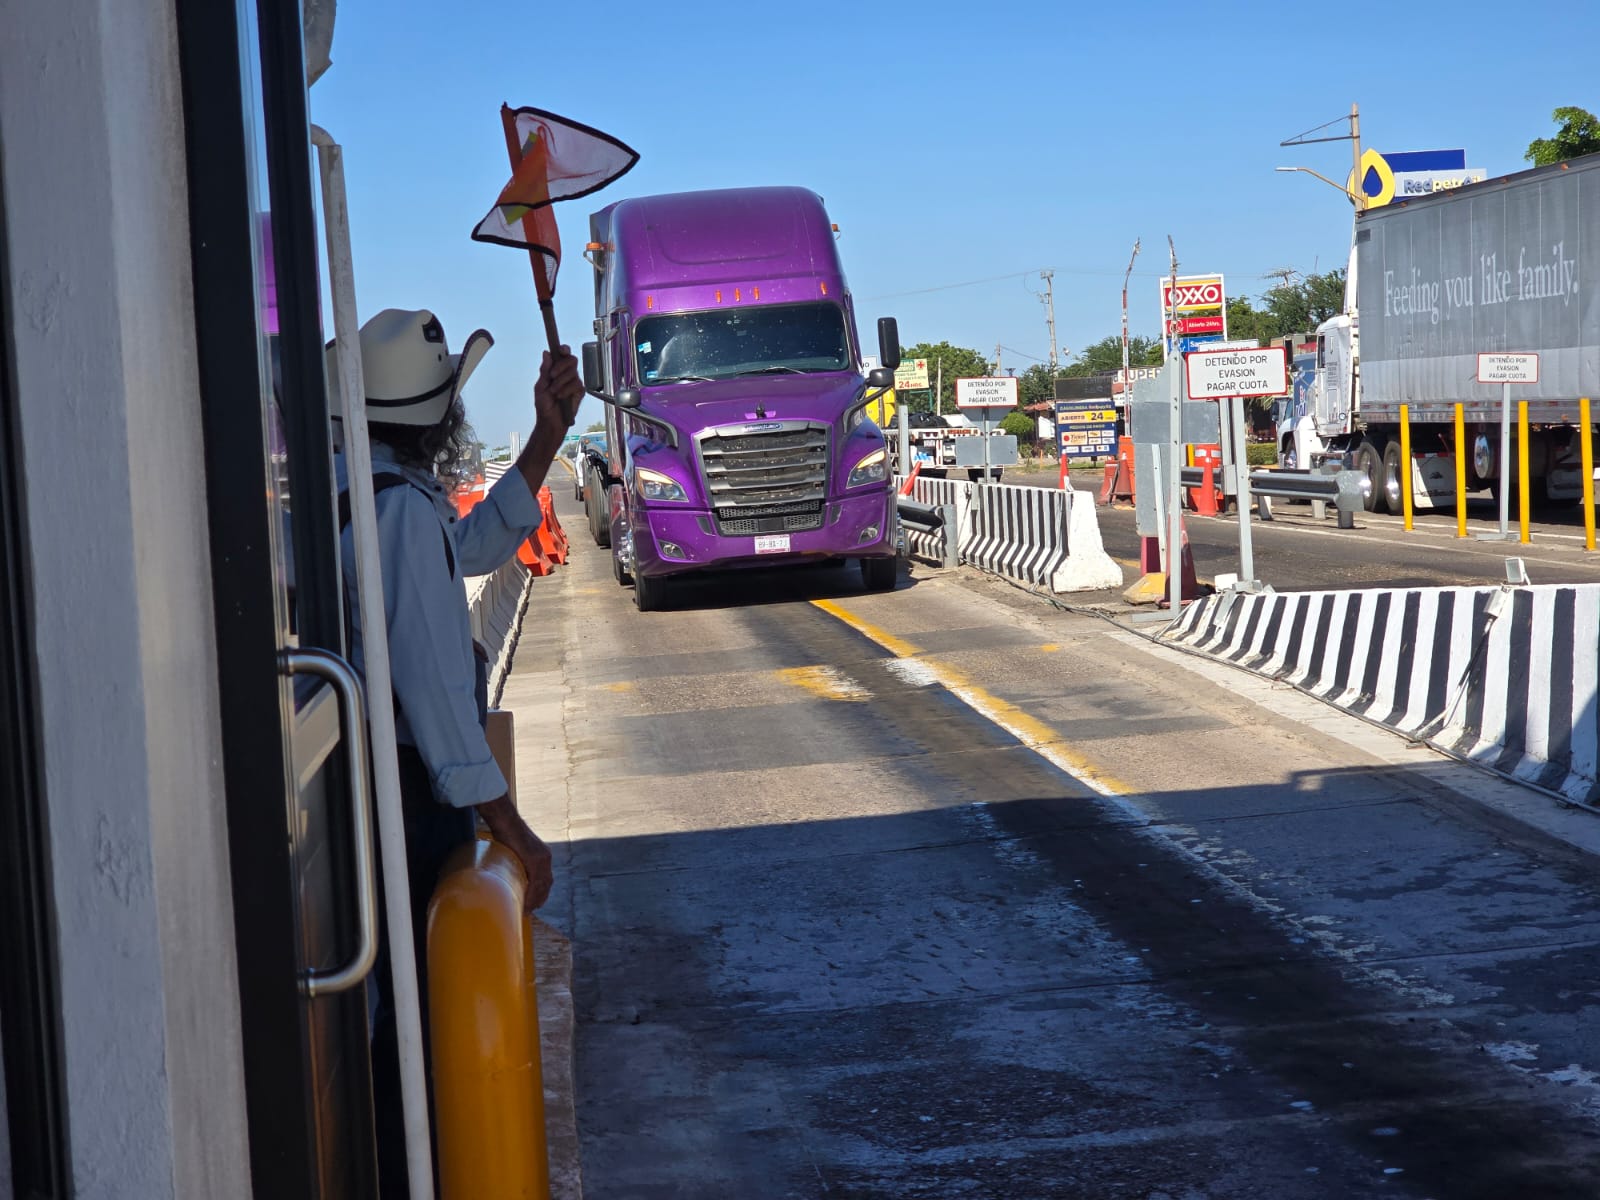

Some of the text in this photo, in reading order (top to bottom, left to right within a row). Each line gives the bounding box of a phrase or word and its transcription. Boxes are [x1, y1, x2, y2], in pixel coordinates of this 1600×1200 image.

[1384, 240, 1579, 324] Feeding you like family.
[1168, 284, 1219, 306] OXXO
[1205, 355, 1268, 366] DETENIDO POR
[1219, 368, 1256, 378] EVASION
[1206, 380, 1268, 391] PAGAR CUOTA
[1091, 412, 1104, 420] 24
